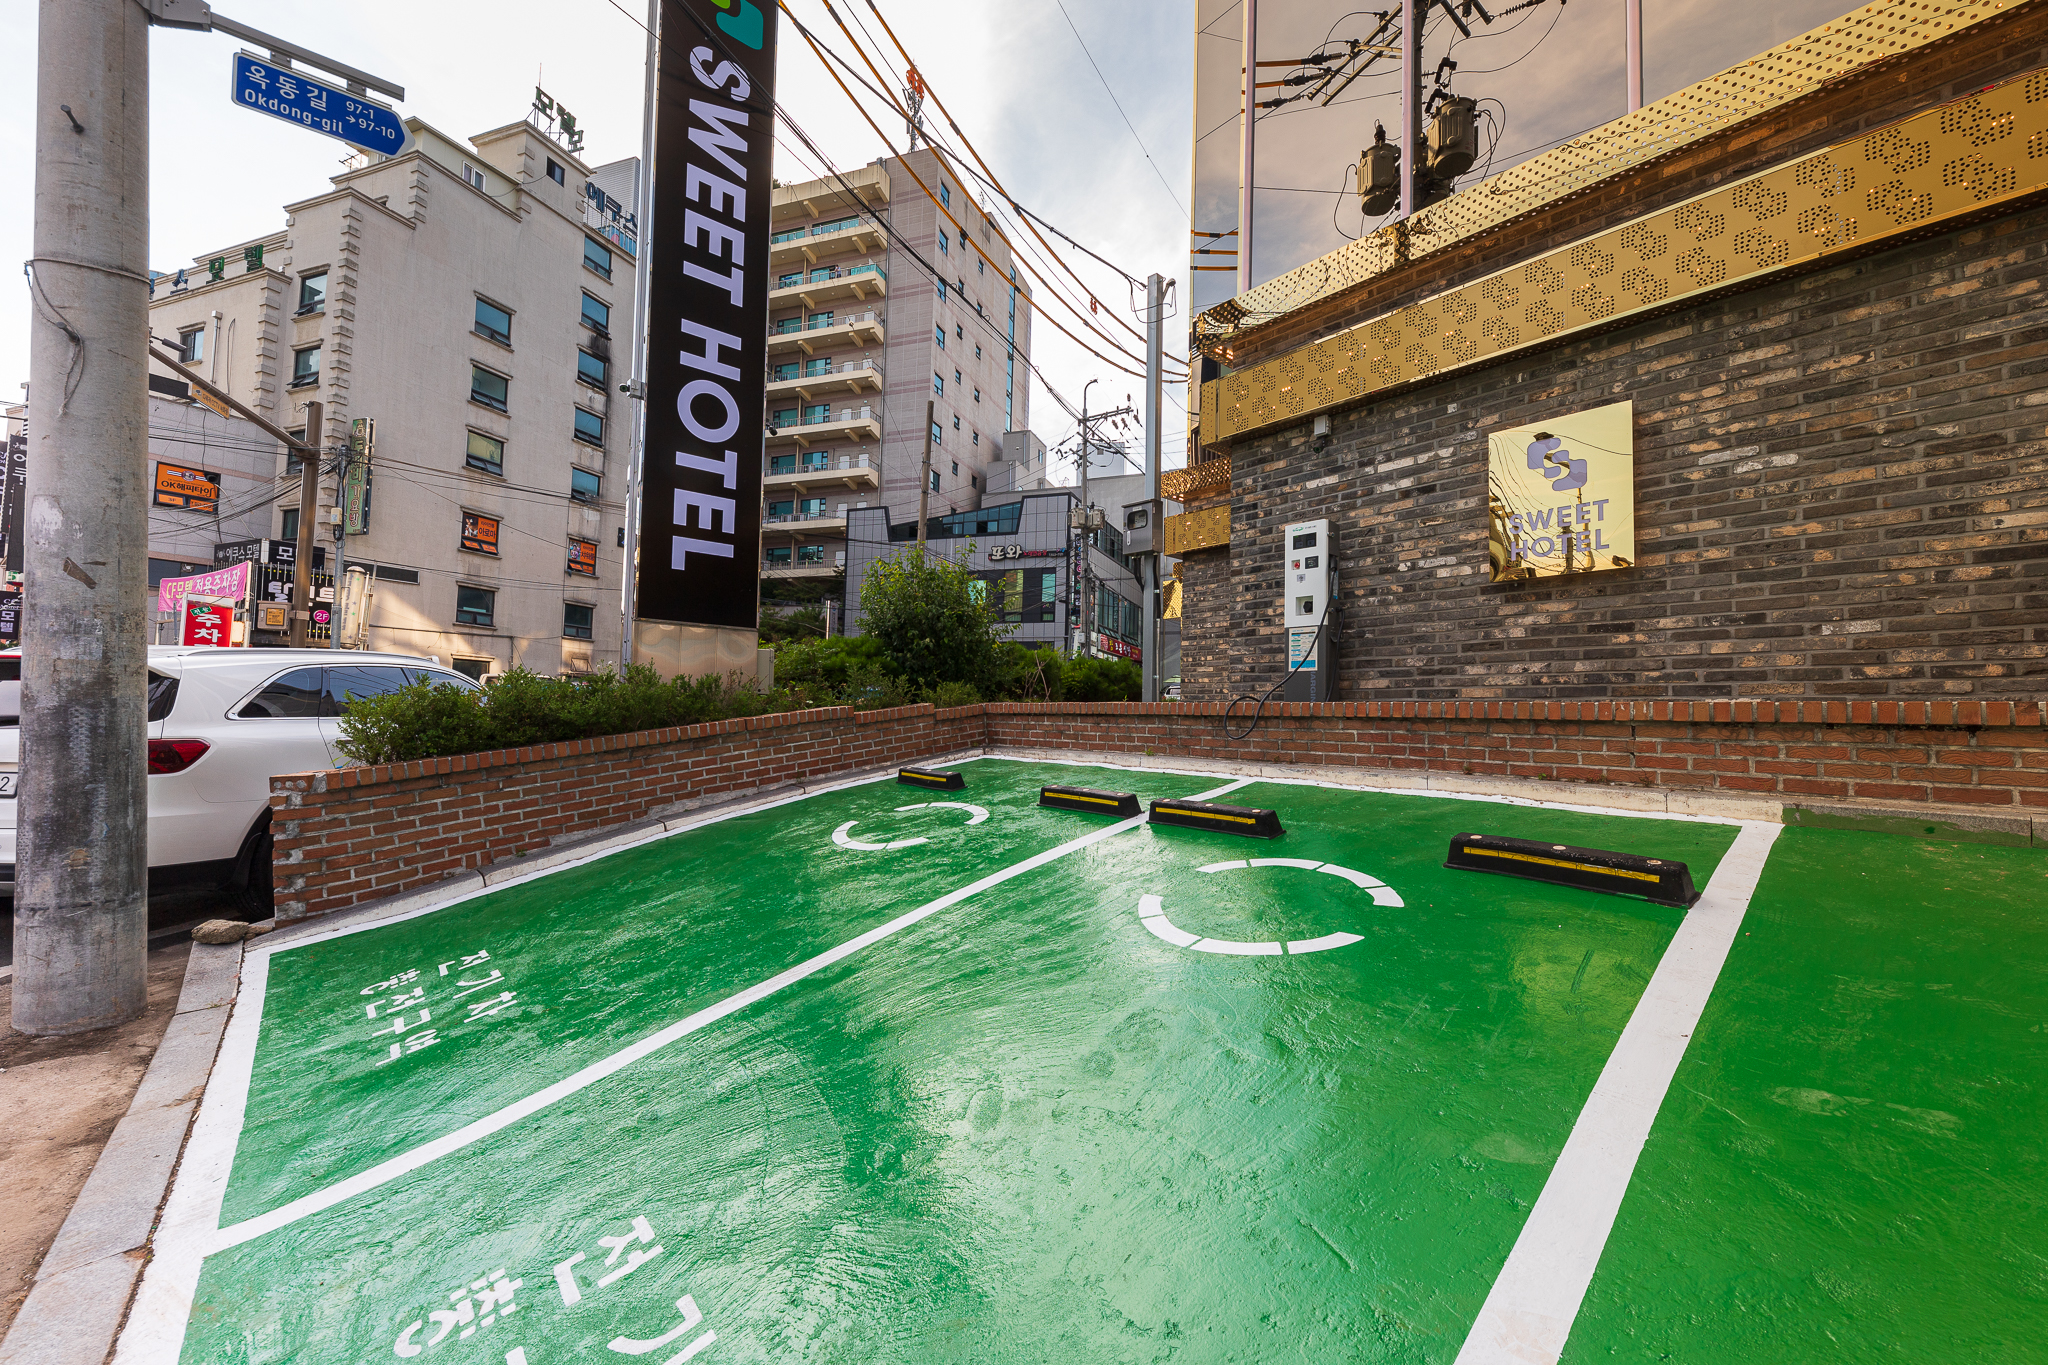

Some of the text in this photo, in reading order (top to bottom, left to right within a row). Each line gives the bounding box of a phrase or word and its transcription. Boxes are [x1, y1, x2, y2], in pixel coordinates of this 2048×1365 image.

[245, 65, 327, 112] 옥동길
[245, 88, 343, 134] Okdong-gil
[346, 101, 374, 119] 97-1
[358, 117, 395, 140] 97-10
[671, 46, 751, 571] SWEET HOTEL
[1509, 499, 1609, 534] SWEET
[478, 527, 496, 539] 아로마
[1510, 529, 1610, 561] HOTEL
[276, 546, 297, 561] 모
[991, 544, 1022, 560] 또와
[315, 612, 329, 620] 2F
[194, 614, 222, 648] 주차
